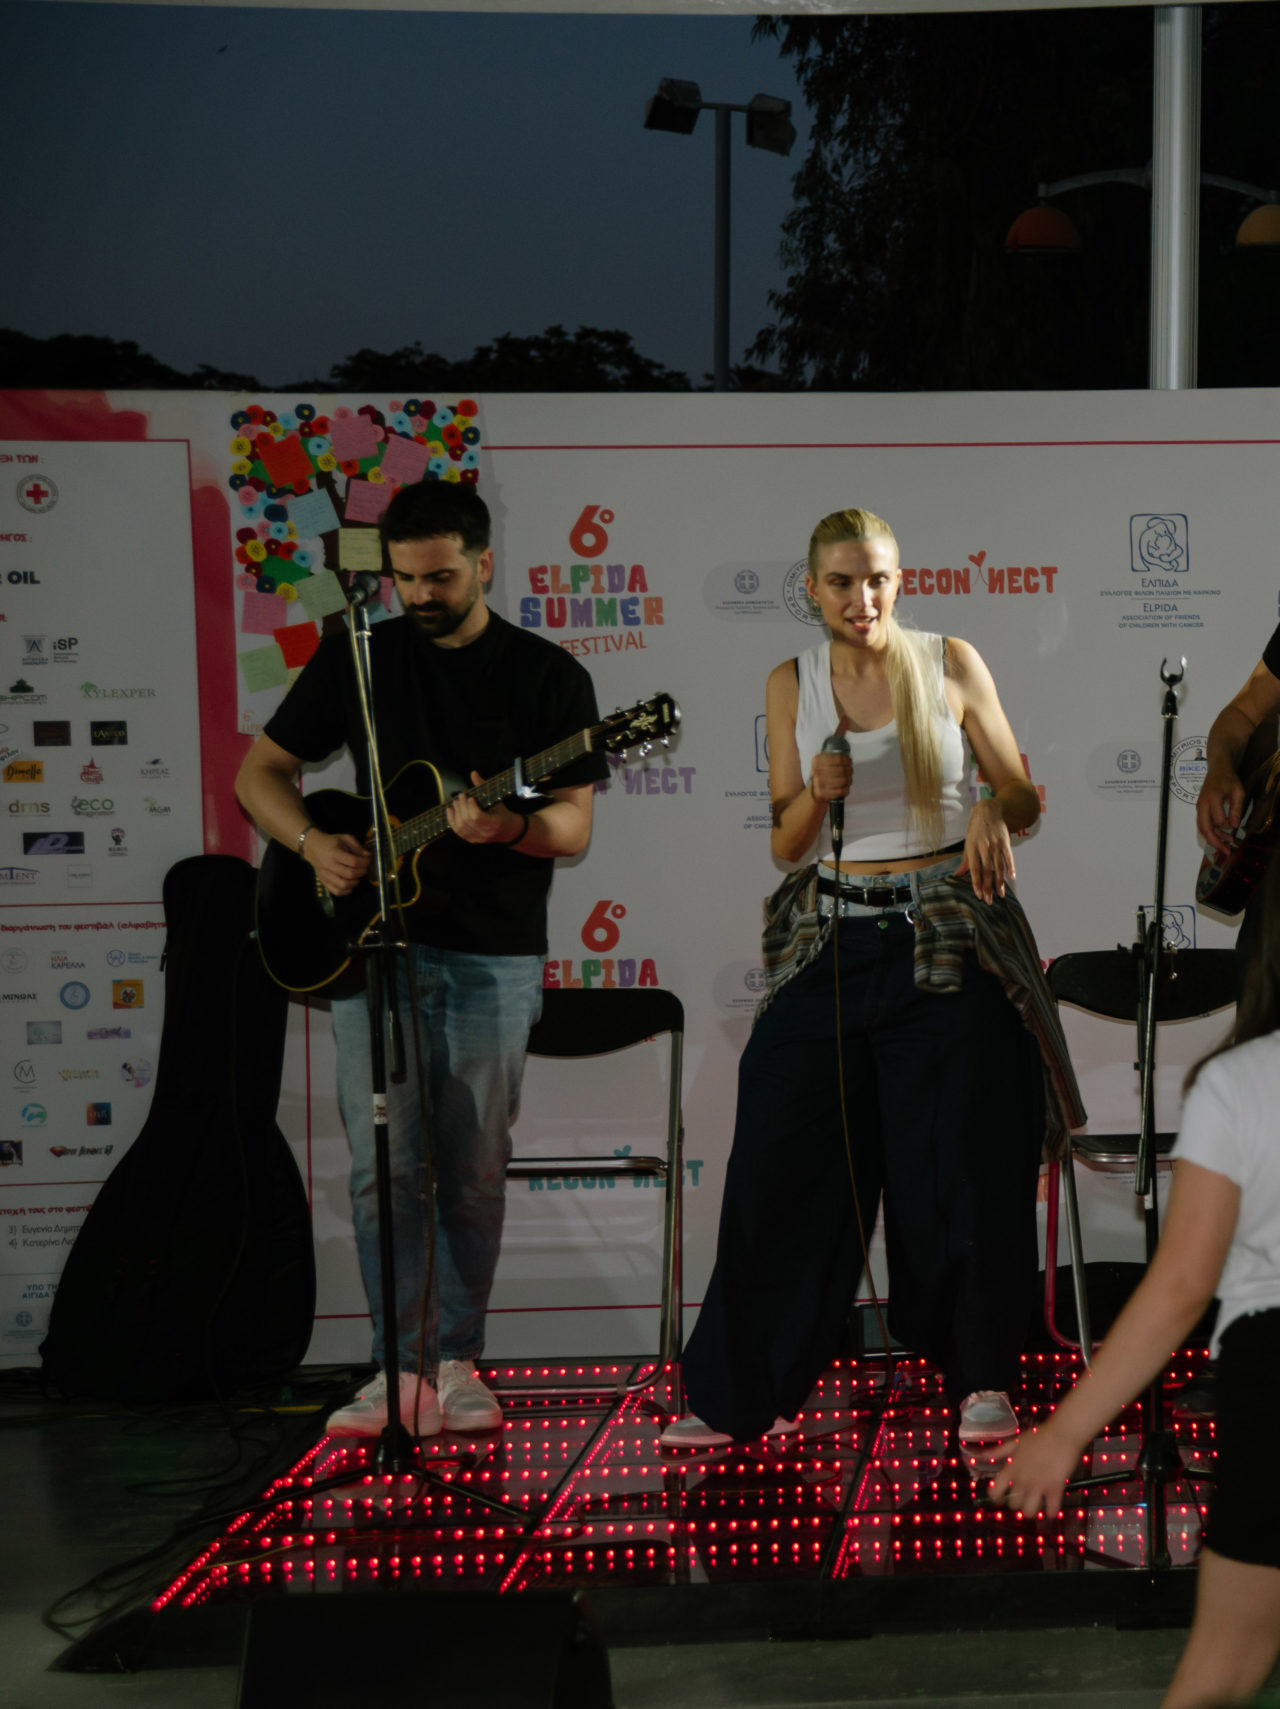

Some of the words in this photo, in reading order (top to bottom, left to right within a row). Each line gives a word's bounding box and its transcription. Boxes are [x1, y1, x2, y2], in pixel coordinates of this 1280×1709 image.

[7, 571, 41, 585] OIL
[528, 564, 648, 594] ELPIDA
[1141, 577, 1180, 588] ΕΛΠΙΔΑ
[520, 596, 664, 628] SUMMER
[1143, 602, 1179, 613] ELPIDA
[543, 958, 659, 989] ELPIDA
